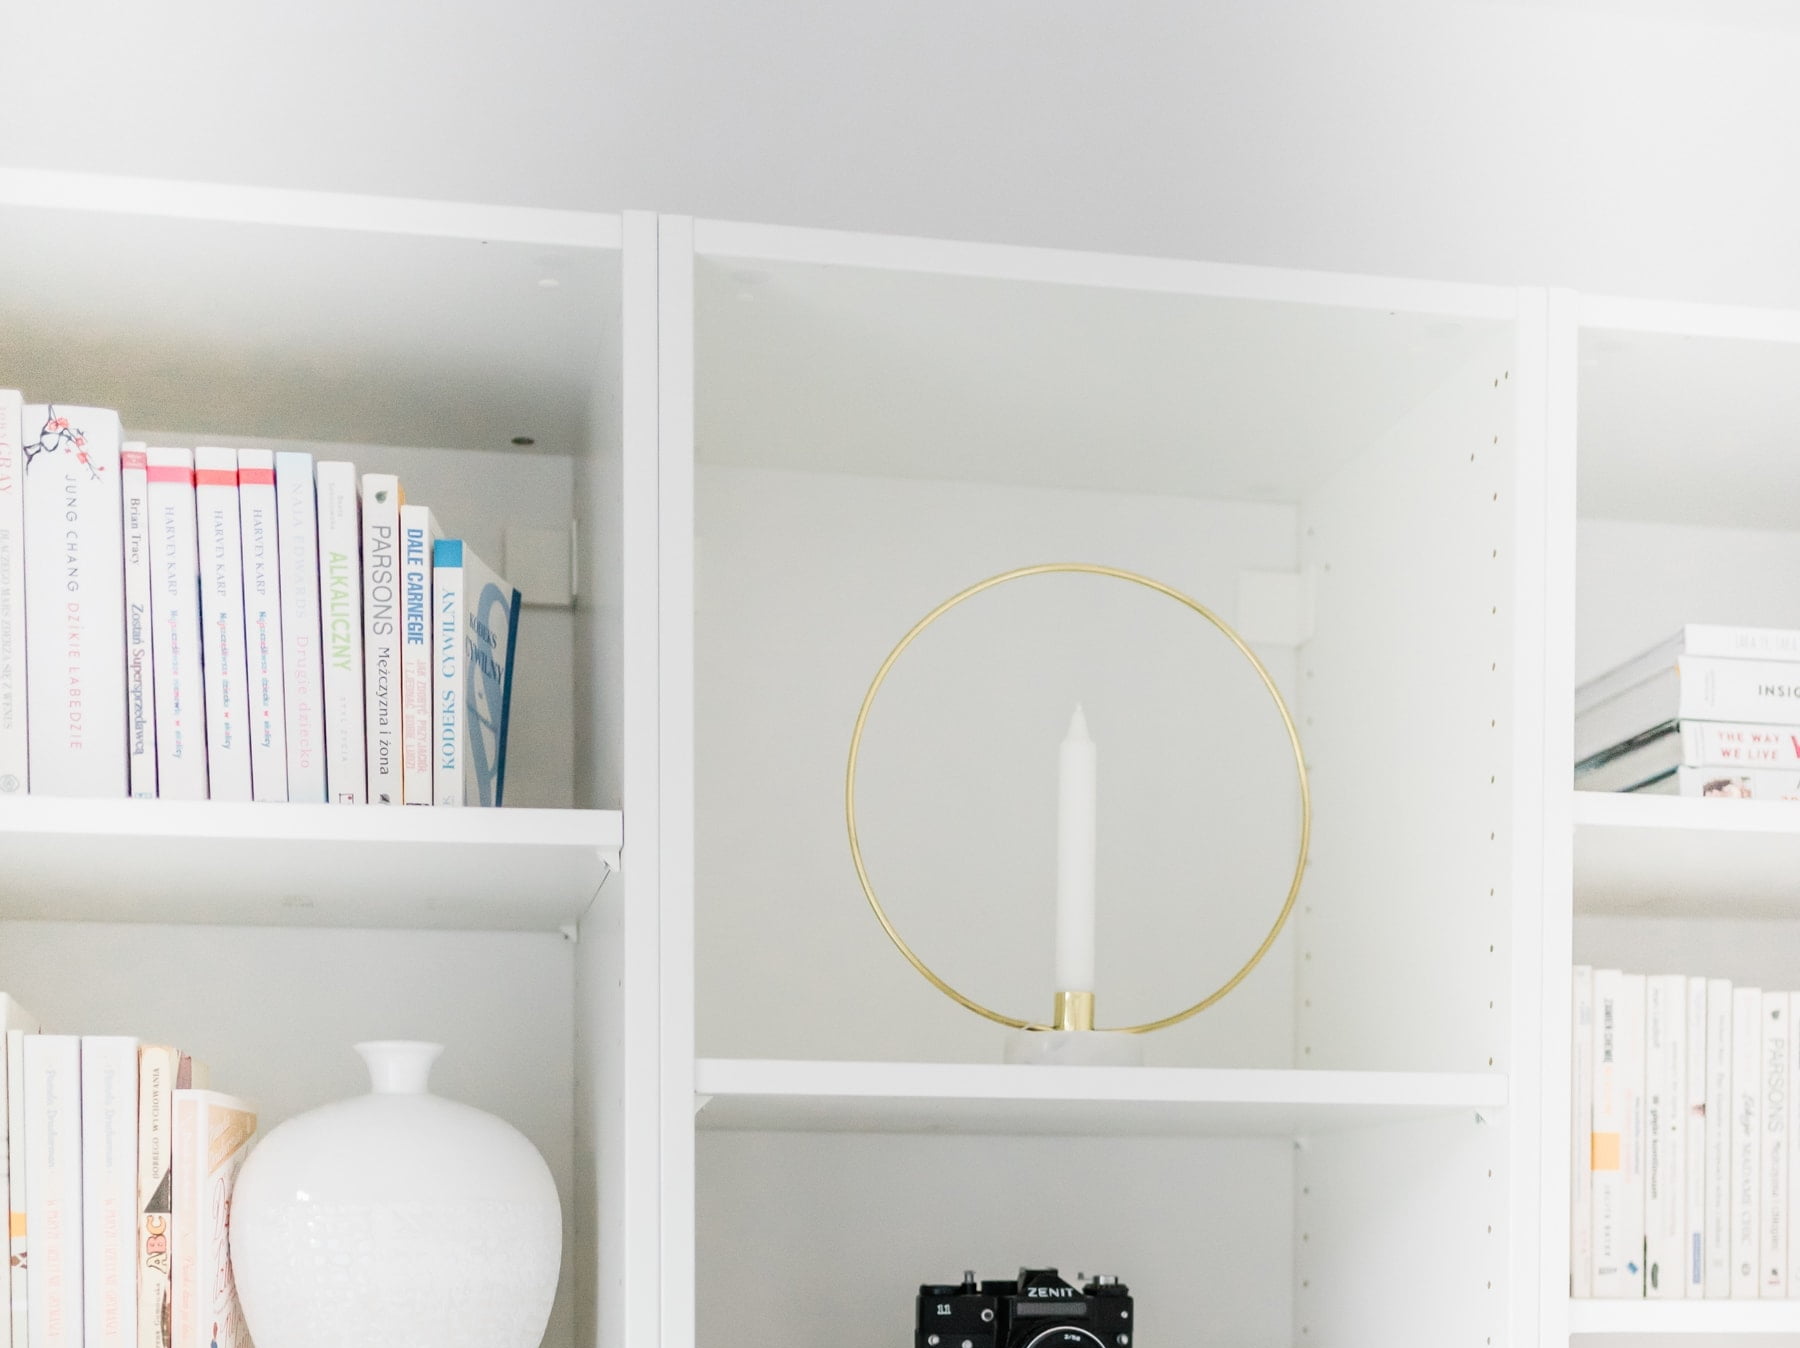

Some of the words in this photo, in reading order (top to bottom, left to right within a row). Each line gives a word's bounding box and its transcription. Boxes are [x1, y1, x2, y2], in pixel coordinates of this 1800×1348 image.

[65, 473, 77, 521] JUNG
[130, 497, 141, 529] Brian
[130, 533, 142, 565] Tracy
[164, 506, 176, 559] HARVEY
[214, 509, 226, 560] HARVEY
[253, 509, 264, 559] HARVEY
[406, 528, 423, 566] DALE
[66, 530, 79, 592] CHANG
[165, 563, 177, 596] KARP
[215, 563, 227, 596] KARP
[254, 563, 266, 596] KARP
[292, 534, 307, 618] EDWARDS
[371, 525, 393, 636] PARSONS
[131, 603, 145, 644] Zostań
[328, 551, 353, 671] ALKALICZNY
[407, 572, 425, 645] CARNEGIE
[442, 588, 455, 678] CYWILNY
[293, 635, 311, 694] Drugie
[377, 646, 391, 726] Mężczyzna
[131, 648, 146, 755] Supersprzedawcą
[296, 702, 314, 769] dziecko
[441, 690, 455, 770] KODEKS
[1718, 731, 1744, 742] THE
[1752, 732, 1781, 743] WAY
[1721, 747, 1740, 758] WE
[1747, 748, 1778, 760] LIVE
[378, 738, 391, 776] żona
[151, 1067, 161, 1131] WYCHOWANIA
[1768, 1037, 1785, 1133] PARSONS
[145, 1215, 168, 1275] ABC
[1027, 1287, 1074, 1298] ZENIT
